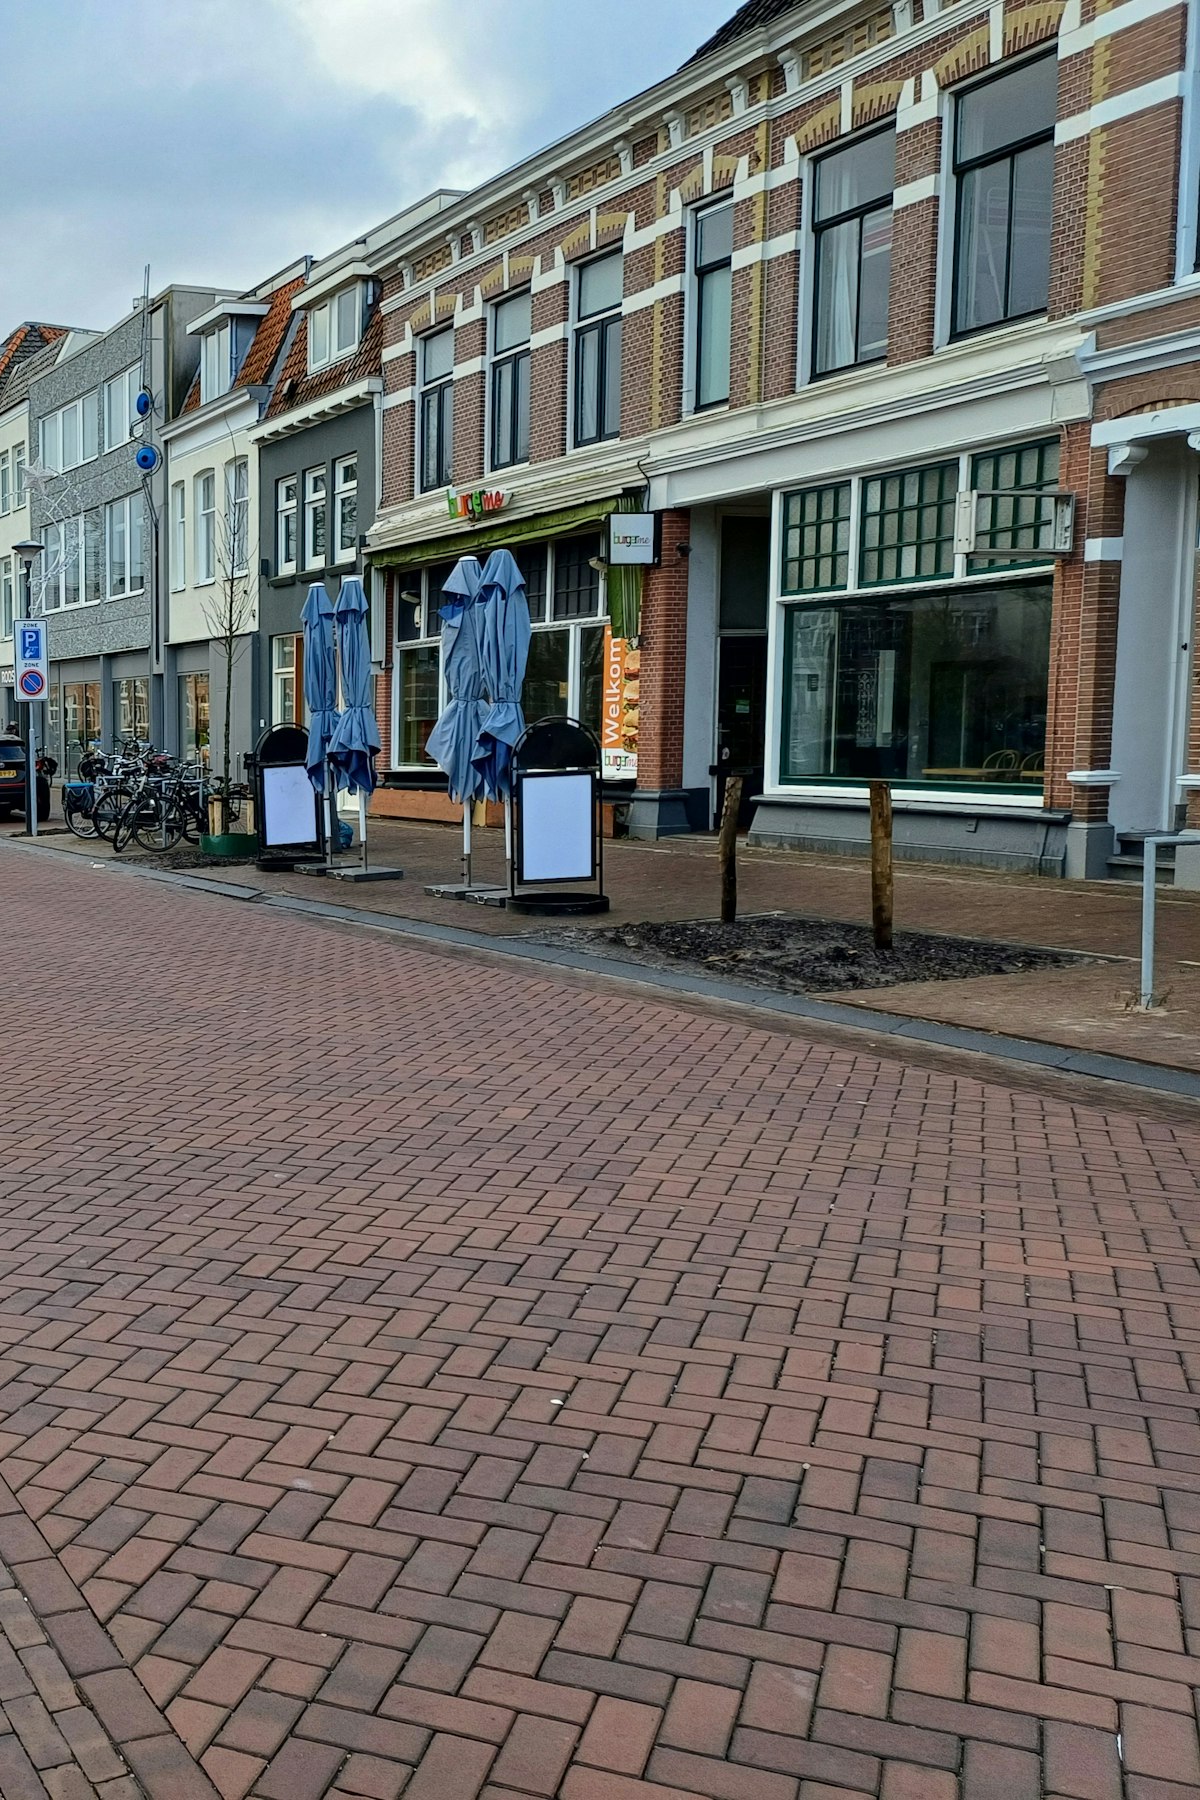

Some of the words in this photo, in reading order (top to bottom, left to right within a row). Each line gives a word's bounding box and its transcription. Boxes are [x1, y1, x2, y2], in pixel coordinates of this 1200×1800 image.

[613, 531, 650, 547] burgerme
[25, 632, 36, 648] P
[604, 631, 622, 744] Welkom
